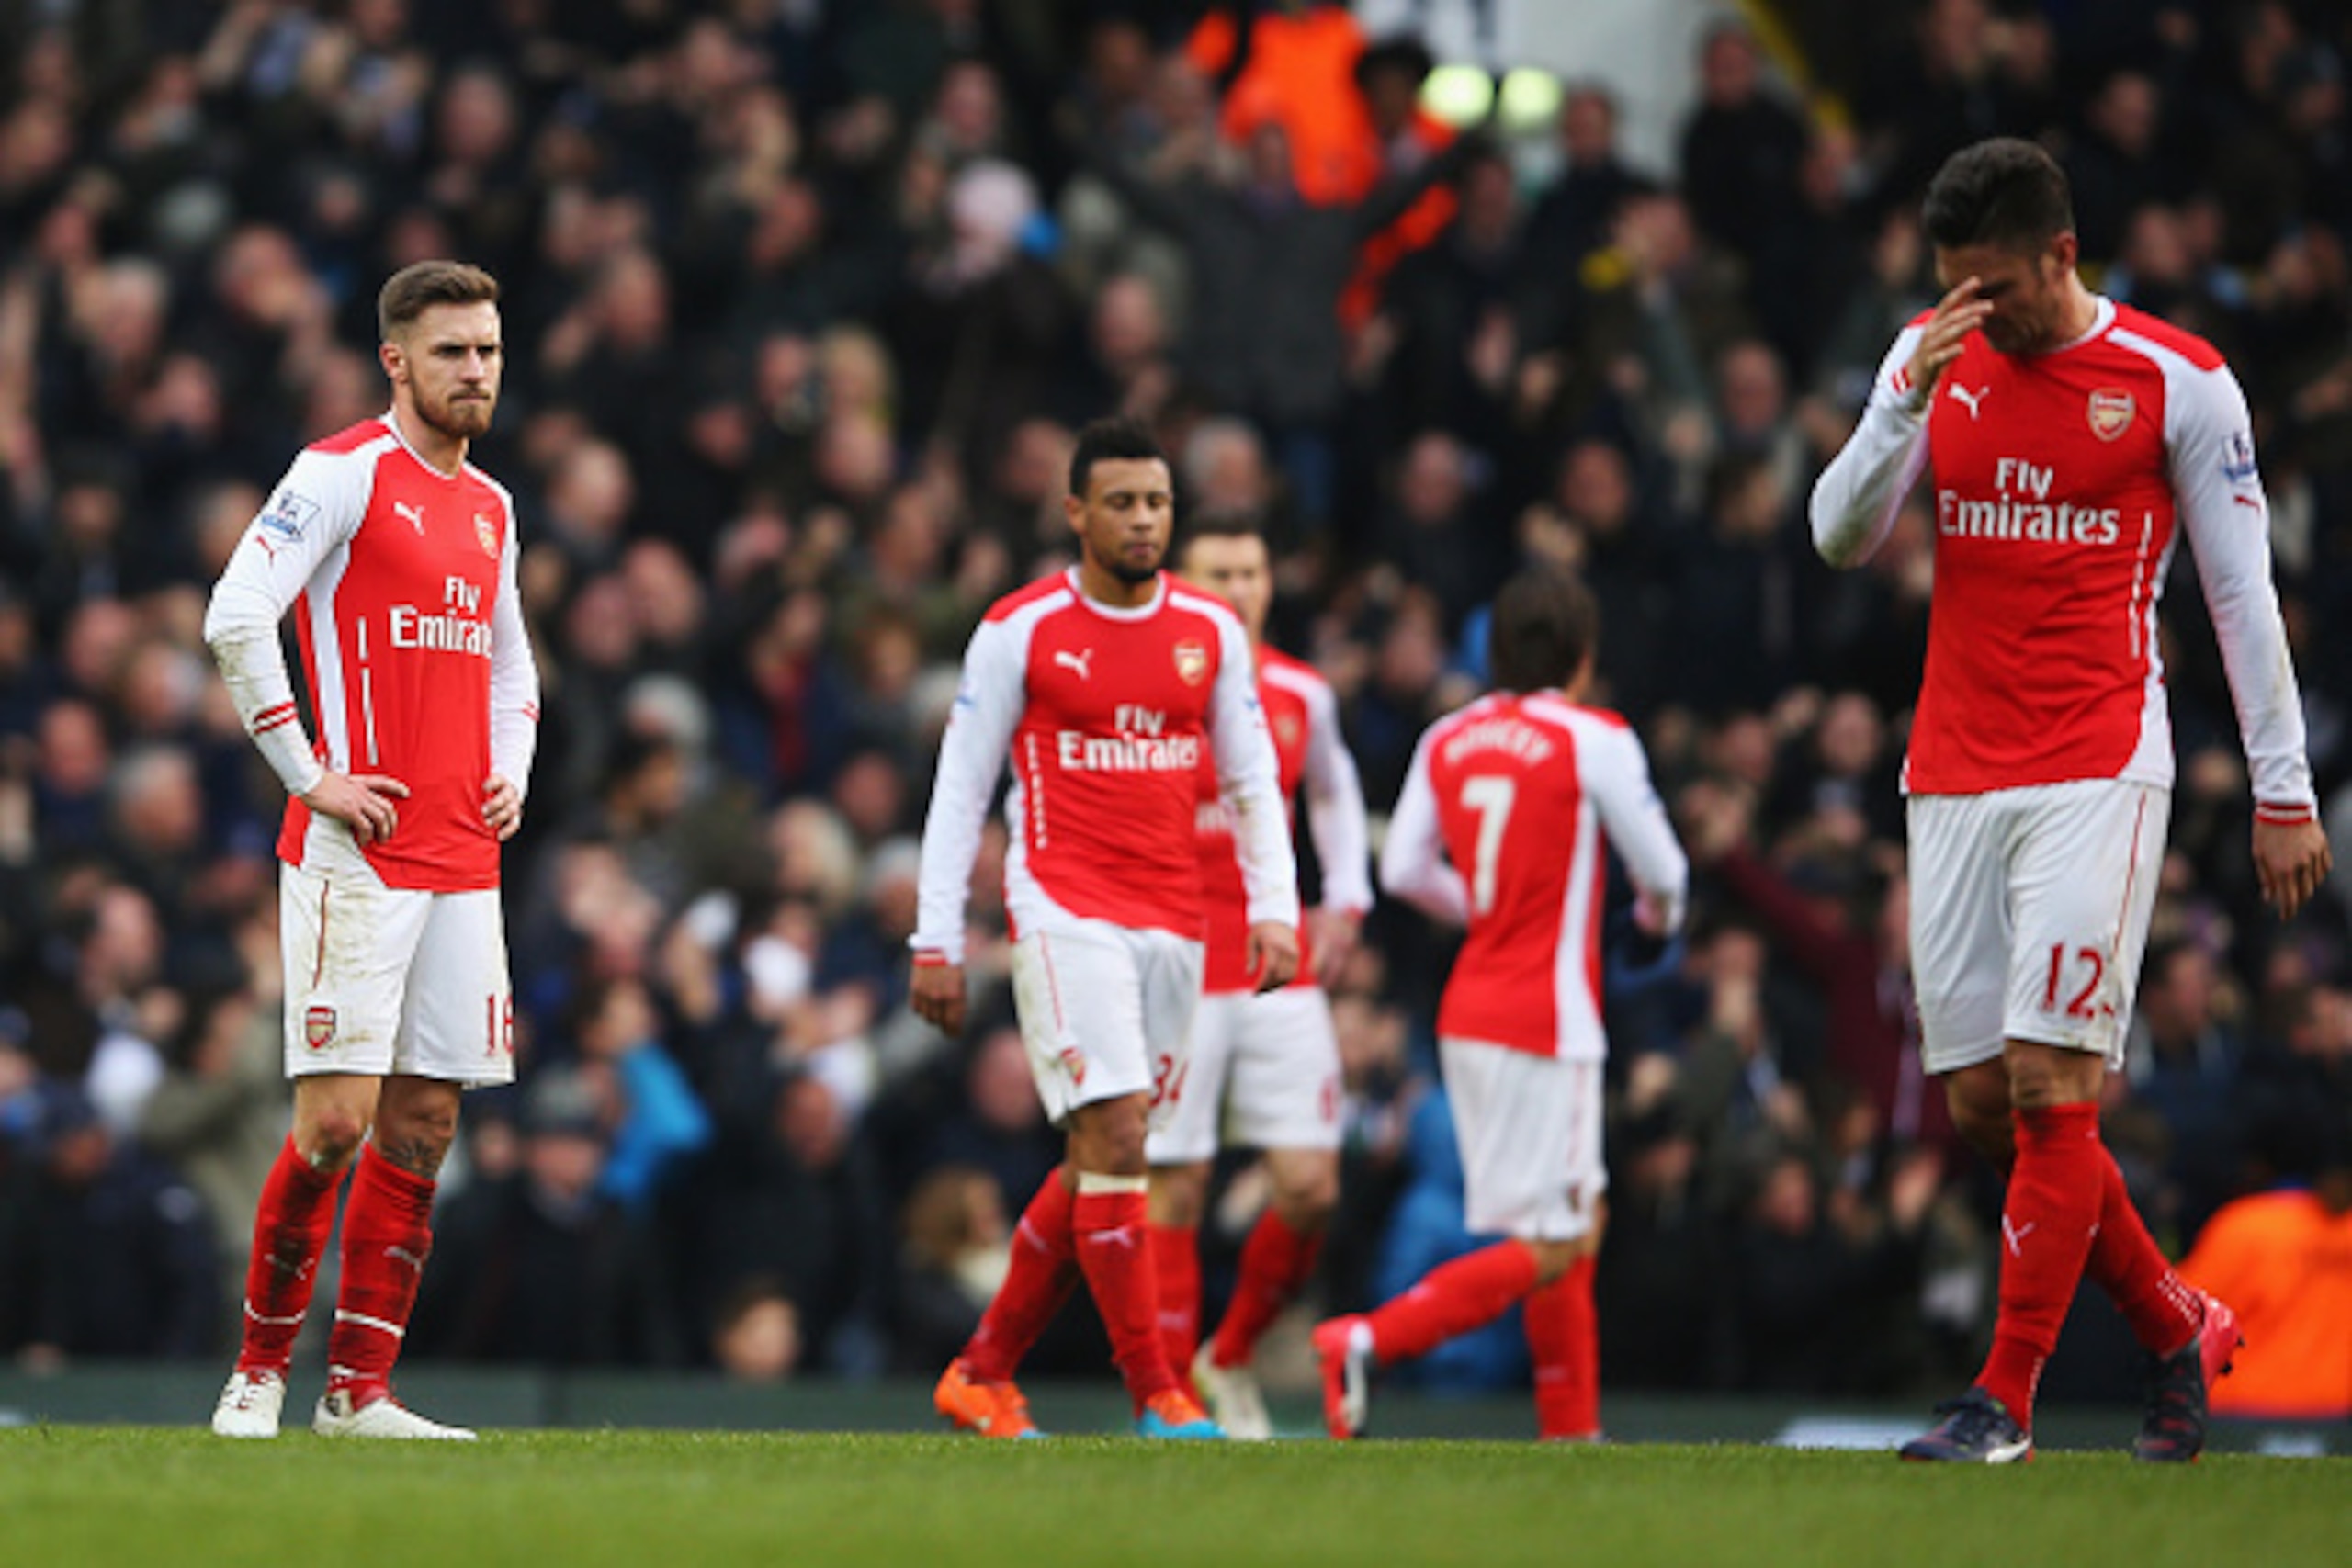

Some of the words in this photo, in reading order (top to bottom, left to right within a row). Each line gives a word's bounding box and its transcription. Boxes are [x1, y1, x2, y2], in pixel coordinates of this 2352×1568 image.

[1996, 457, 2053, 499] Fly
[1939, 490, 2120, 545] Emirates
[444, 576, 481, 615] Fly
[1114, 705, 1166, 738] Fly
[1058, 731, 1198, 770] Emirates
[1461, 776, 1516, 915] 7
[2041, 942, 2104, 1020] 12
